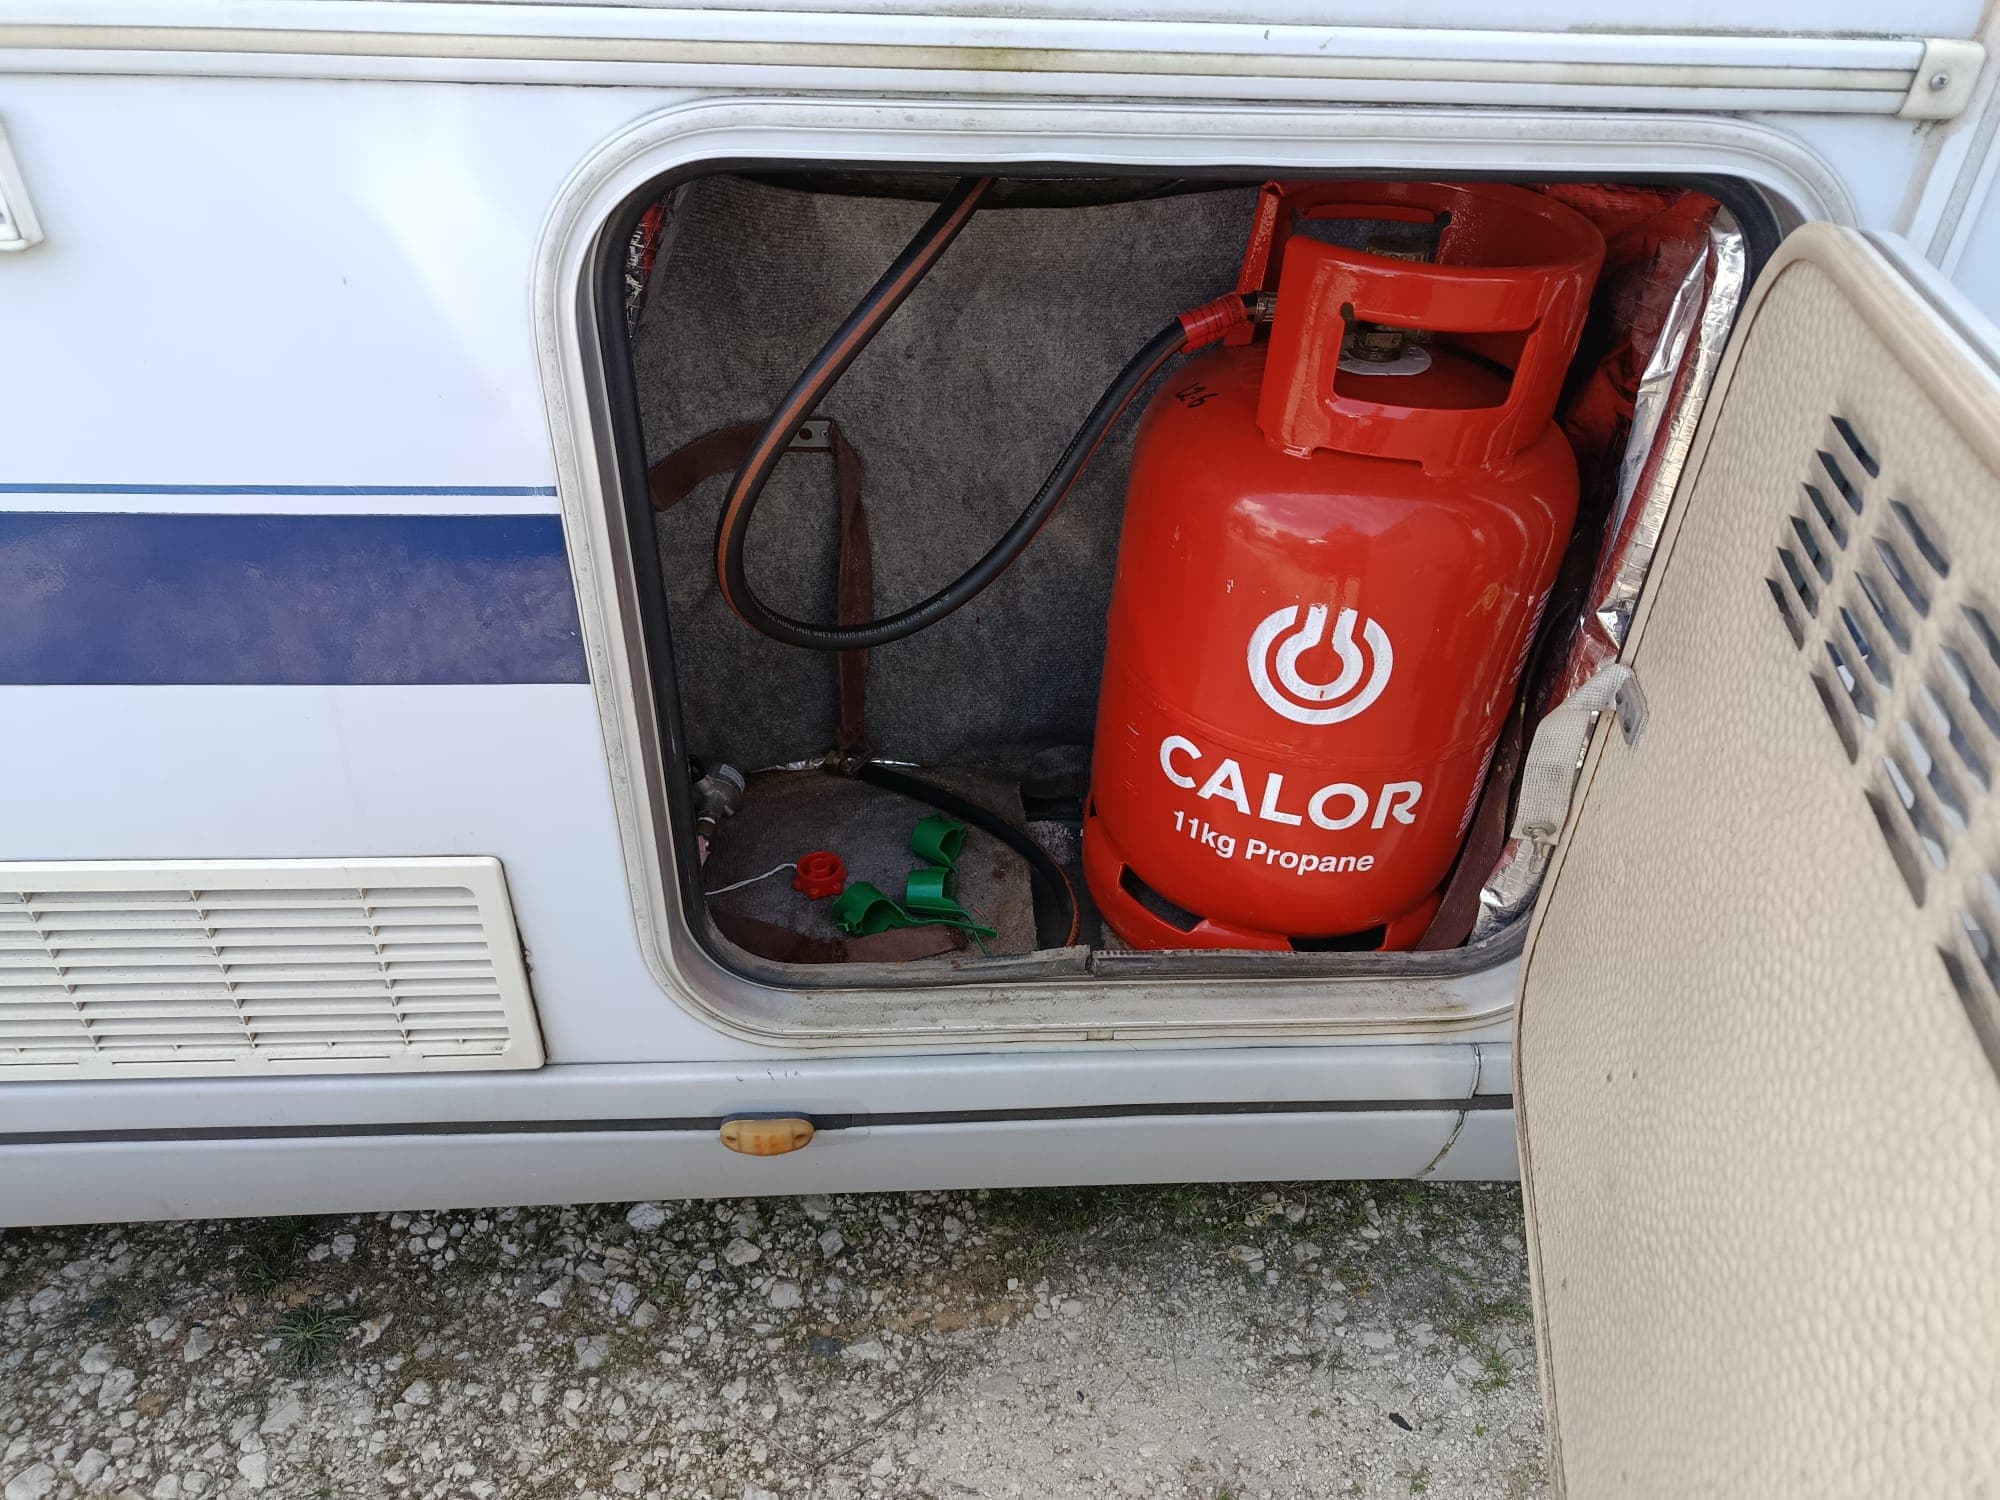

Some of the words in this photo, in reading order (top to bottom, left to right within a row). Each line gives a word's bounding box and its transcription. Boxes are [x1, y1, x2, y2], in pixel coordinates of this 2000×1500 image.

[1159, 735, 1423, 830] CALOR
[1173, 810, 1237, 858] 11kg
[1245, 838, 1375, 876] Propane
